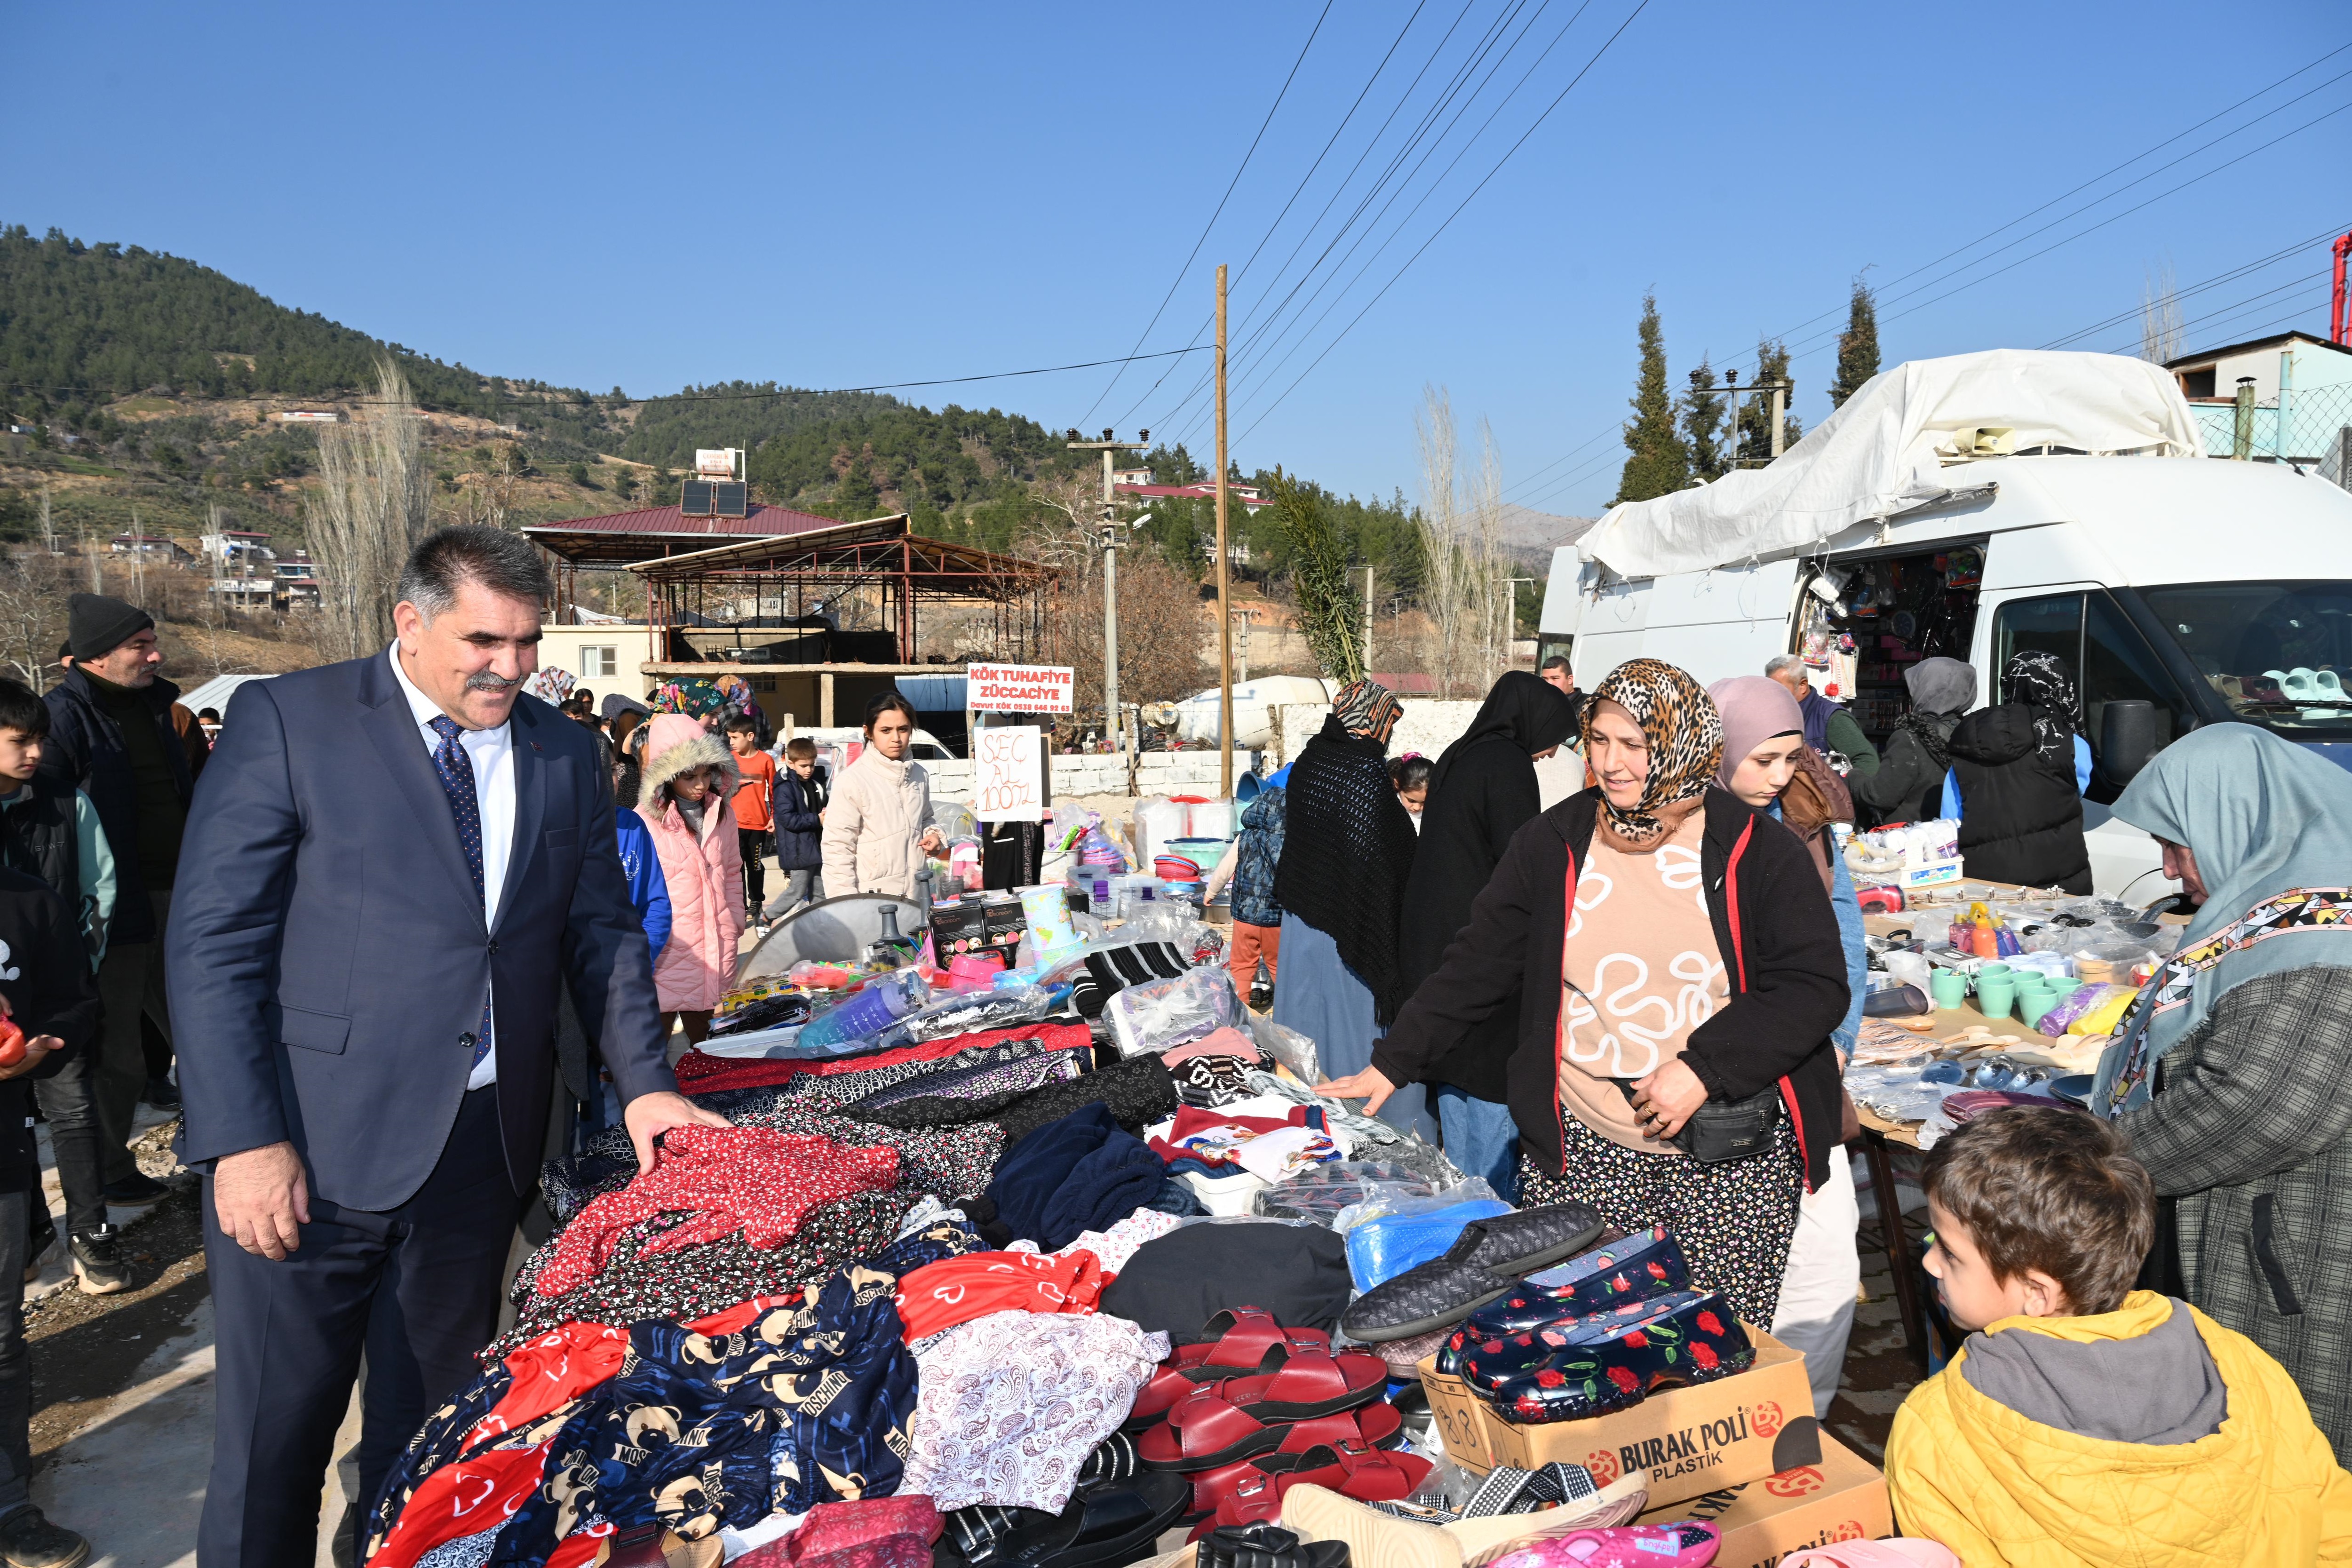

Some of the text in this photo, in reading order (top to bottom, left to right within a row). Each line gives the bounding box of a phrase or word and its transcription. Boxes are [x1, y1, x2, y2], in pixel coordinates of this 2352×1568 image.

[970, 667, 1070, 684] KÖK TUHAFİYE
[980, 684, 1059, 700] ZÜCCACİYE
[982, 734, 1027, 764] SEÇ
[991, 764, 1020, 785] AL
[1619, 1405, 1749, 1474] BURAK POLİ
[1653, 1450, 1724, 1483] PLASTİK
[1644, 1539, 1675, 1554] Ladybug
